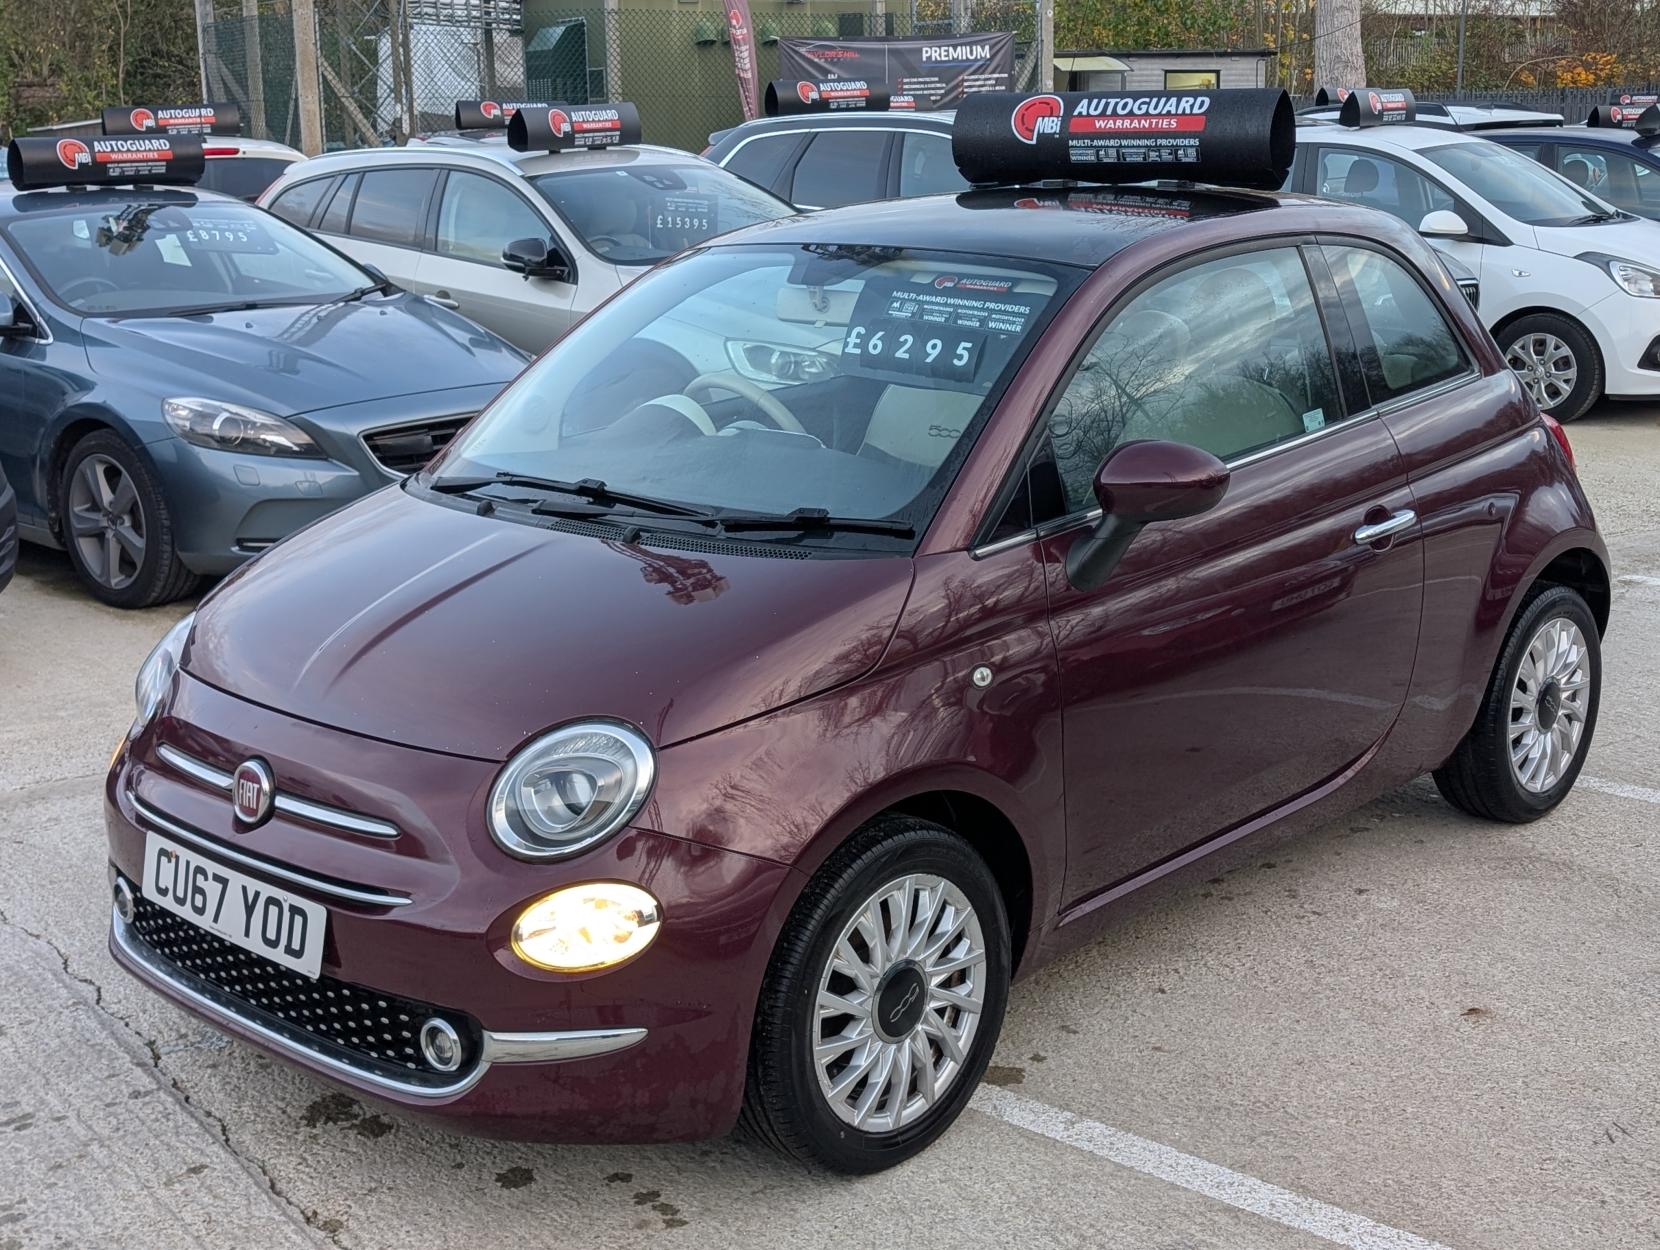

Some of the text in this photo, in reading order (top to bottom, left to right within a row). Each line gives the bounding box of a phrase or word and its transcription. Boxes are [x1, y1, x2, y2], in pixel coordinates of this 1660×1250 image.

[922, 45, 990, 62] PREMIUM
[819, 80, 868, 91] AUTOGUARD
[1073, 96, 1210, 116] AUTOGUARD
[158, 108, 215, 118] AUTOGUARD
[570, 110, 619, 122] AUTOGUARD
[1035, 116, 1062, 134] MBi
[1094, 118, 1177, 129] WARRANTIES
[93, 138, 171, 152] AUTOGUARD
[1069, 138, 1200, 147] MULTI-AWARD WINNING PROVIDERS
[110, 151, 159, 160] WARRANTIES
[656, 215, 708, 230] £15395
[187, 229, 248, 242] £8795
[960, 278, 1012, 288] AUTOGUARD
[892, 291, 1031, 314] MULTI-AWARD WINNING PROVIDERS
[957, 320, 980, 328] WINNER
[988, 320, 1022, 333] WINNER
[845, 326, 973, 367] £6295
[239, 779, 260, 810] FIAT
[154, 847, 309, 960] CU67 YOD
